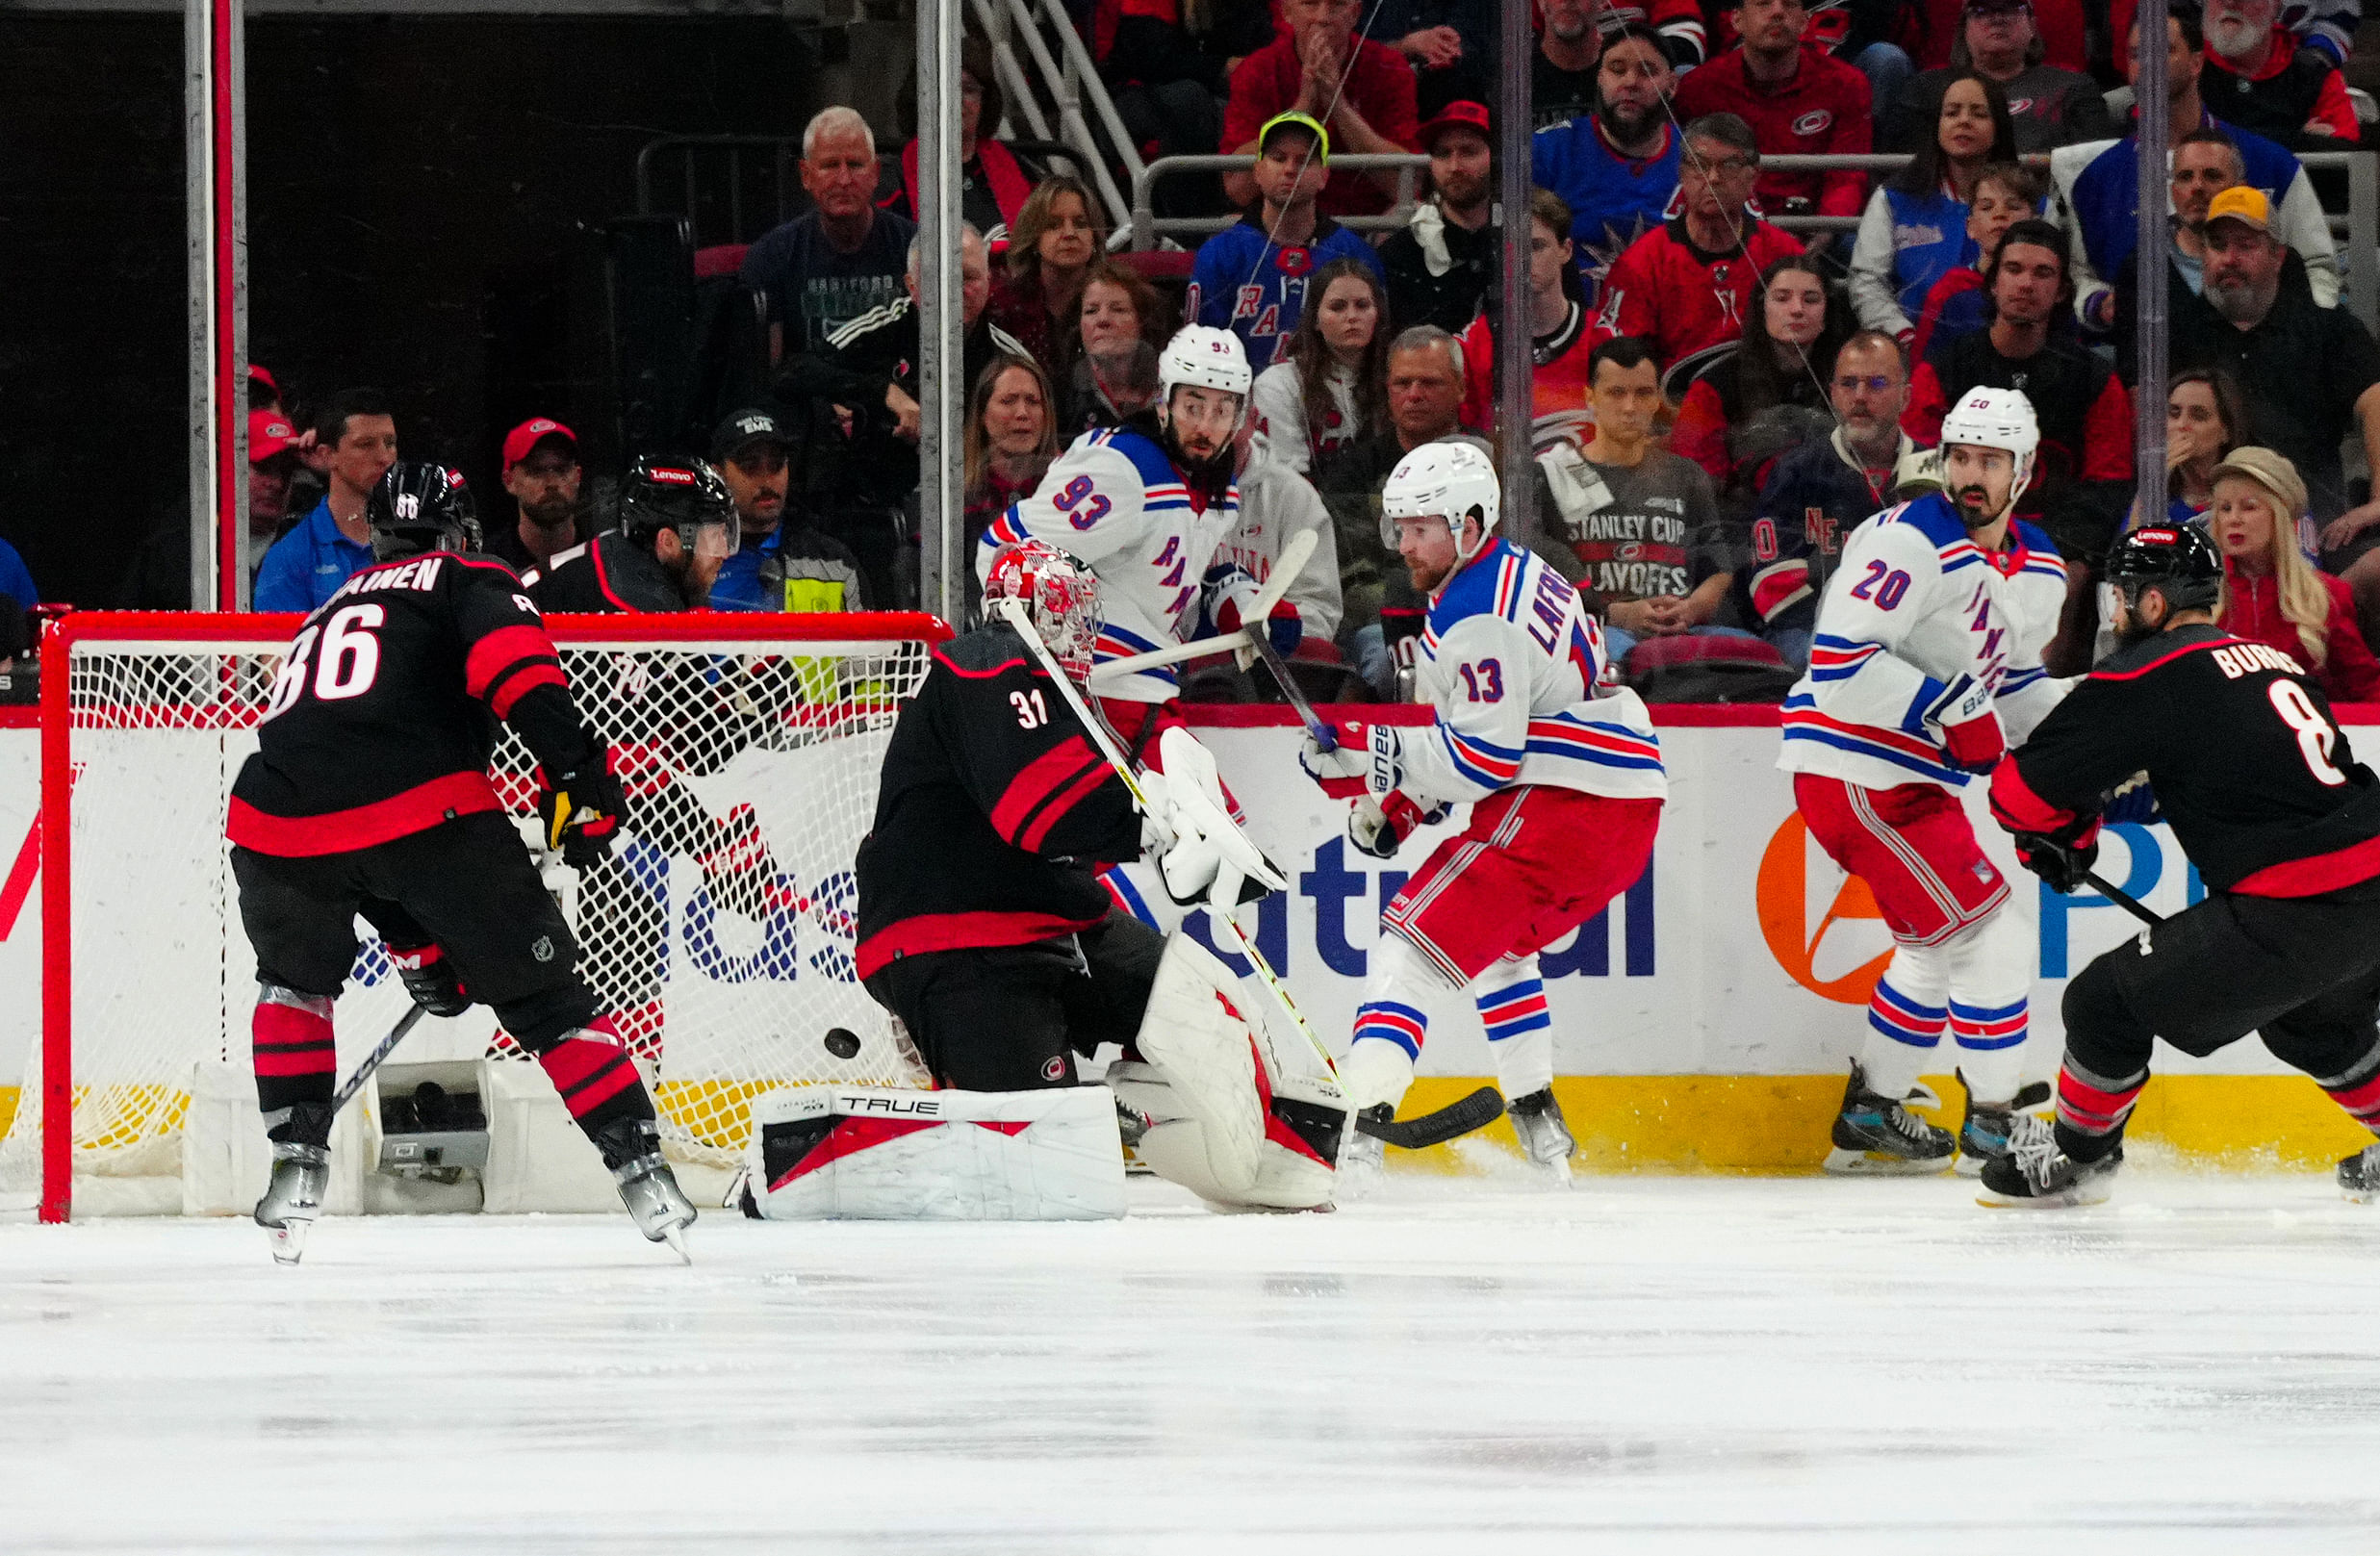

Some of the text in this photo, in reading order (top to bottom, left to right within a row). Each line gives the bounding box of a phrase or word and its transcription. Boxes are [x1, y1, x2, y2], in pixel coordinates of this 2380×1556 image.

[652, 469, 691, 482] Lenovo
[1053, 474, 1112, 531] 93
[1651, 515, 1686, 545] CUP
[1586, 561, 1689, 597] LAYOFFS
[1850, 559, 1912, 612] 20
[258, 602, 385, 725] 86
[1459, 657, 1504, 703] 13
[2211, 644, 2306, 679] BURNS
[1009, 687, 1049, 729] 31
[840, 1096, 940, 1115] TRUE
